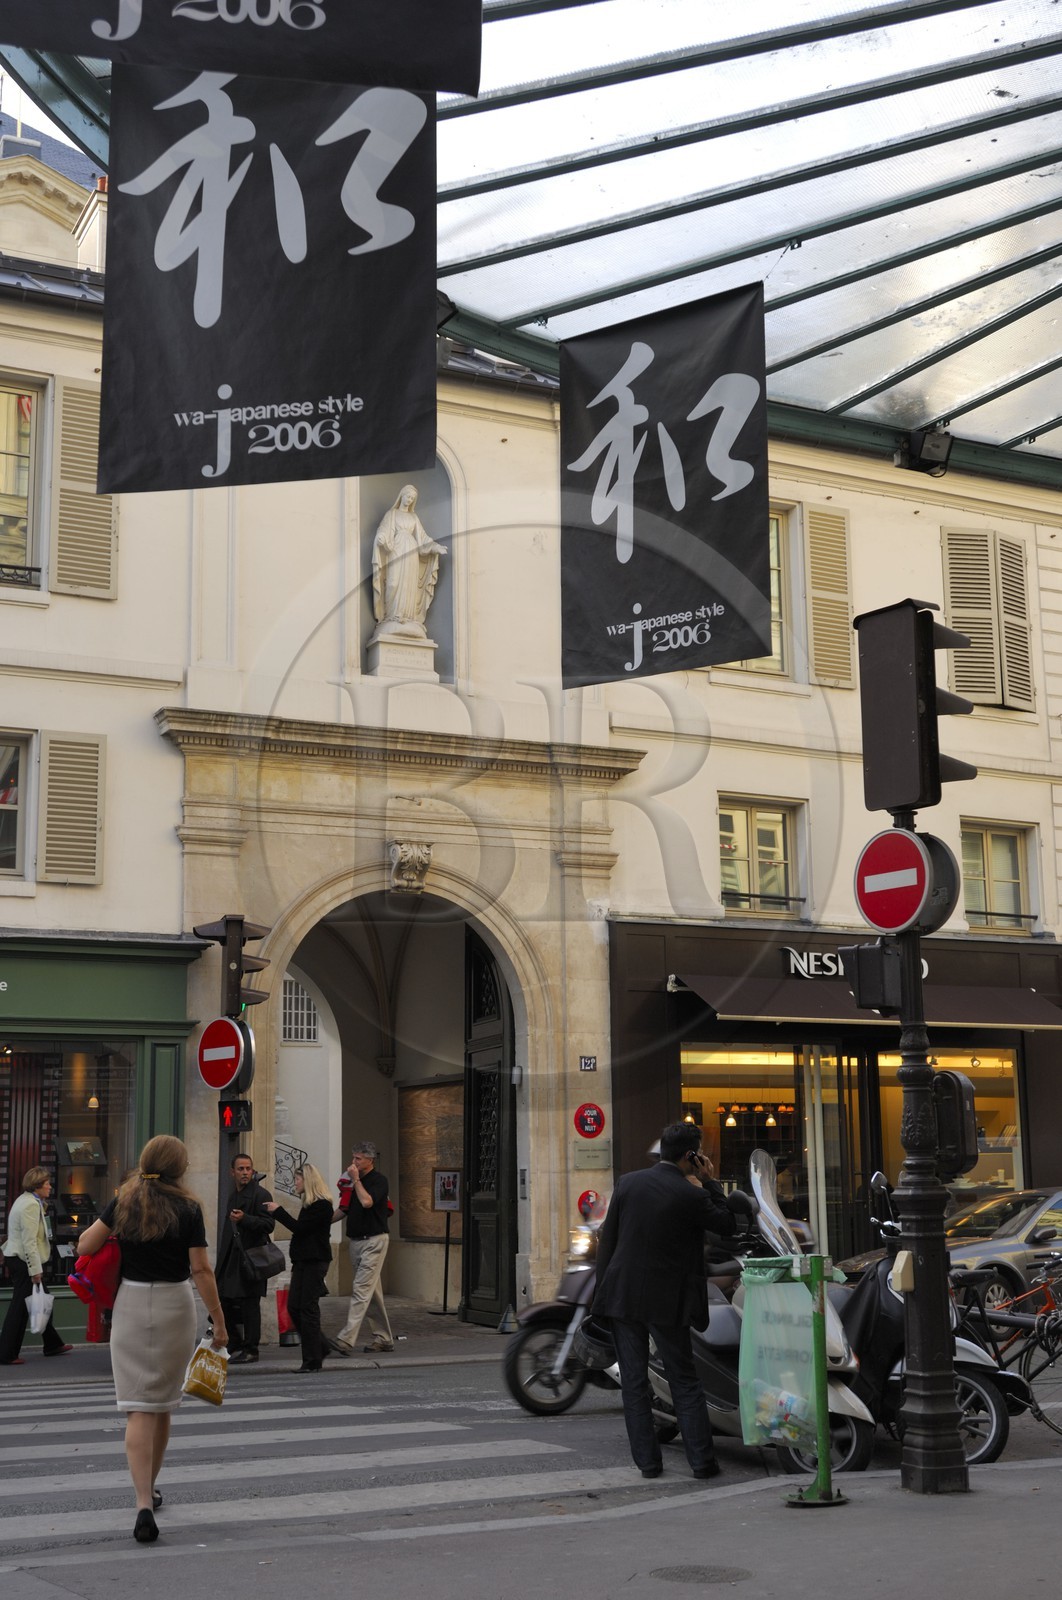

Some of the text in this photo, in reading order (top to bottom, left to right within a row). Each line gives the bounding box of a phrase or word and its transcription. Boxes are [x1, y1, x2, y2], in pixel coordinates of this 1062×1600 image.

[318, 393, 364, 420] style
[247, 418, 342, 455] 2006
[695, 602, 725, 623] style
[652, 621, 712, 653] 2006
[584, 1109, 598, 1117] JOUR
